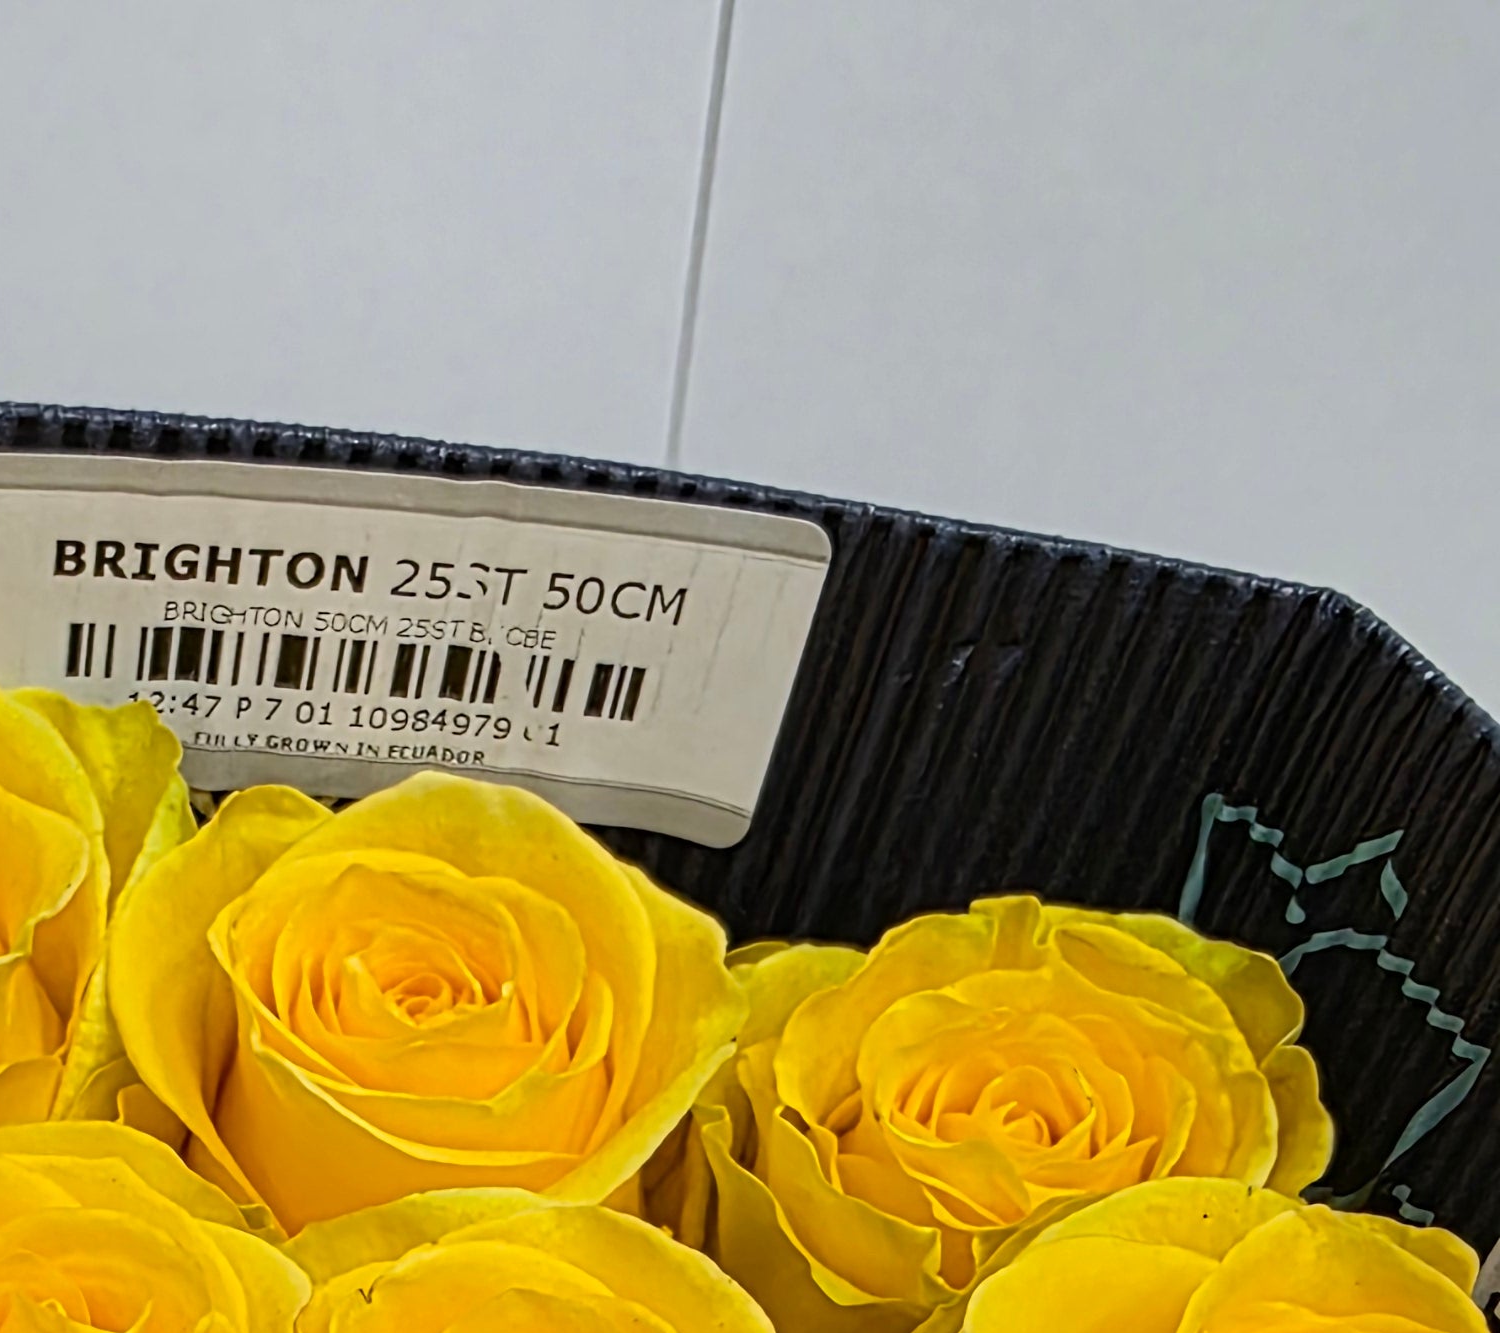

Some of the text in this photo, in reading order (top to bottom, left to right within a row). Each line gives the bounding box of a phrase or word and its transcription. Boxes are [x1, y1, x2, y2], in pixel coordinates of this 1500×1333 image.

[54, 540, 688, 626] BRIGHTON 25ST 50CM
[164, 601, 303, 628] BRIGHTON
[314, 611, 388, 635] 50CM
[396, 617, 465, 640] 25ST
[236, 696, 251, 719] P
[264, 697, 282, 720] 7
[295, 701, 332, 725] 01
[348, 705, 511, 740] 10984979
[266, 735, 350, 756] GROWN
[356, 742, 379, 757] IN
[388, 744, 485, 765] ECUADOR
